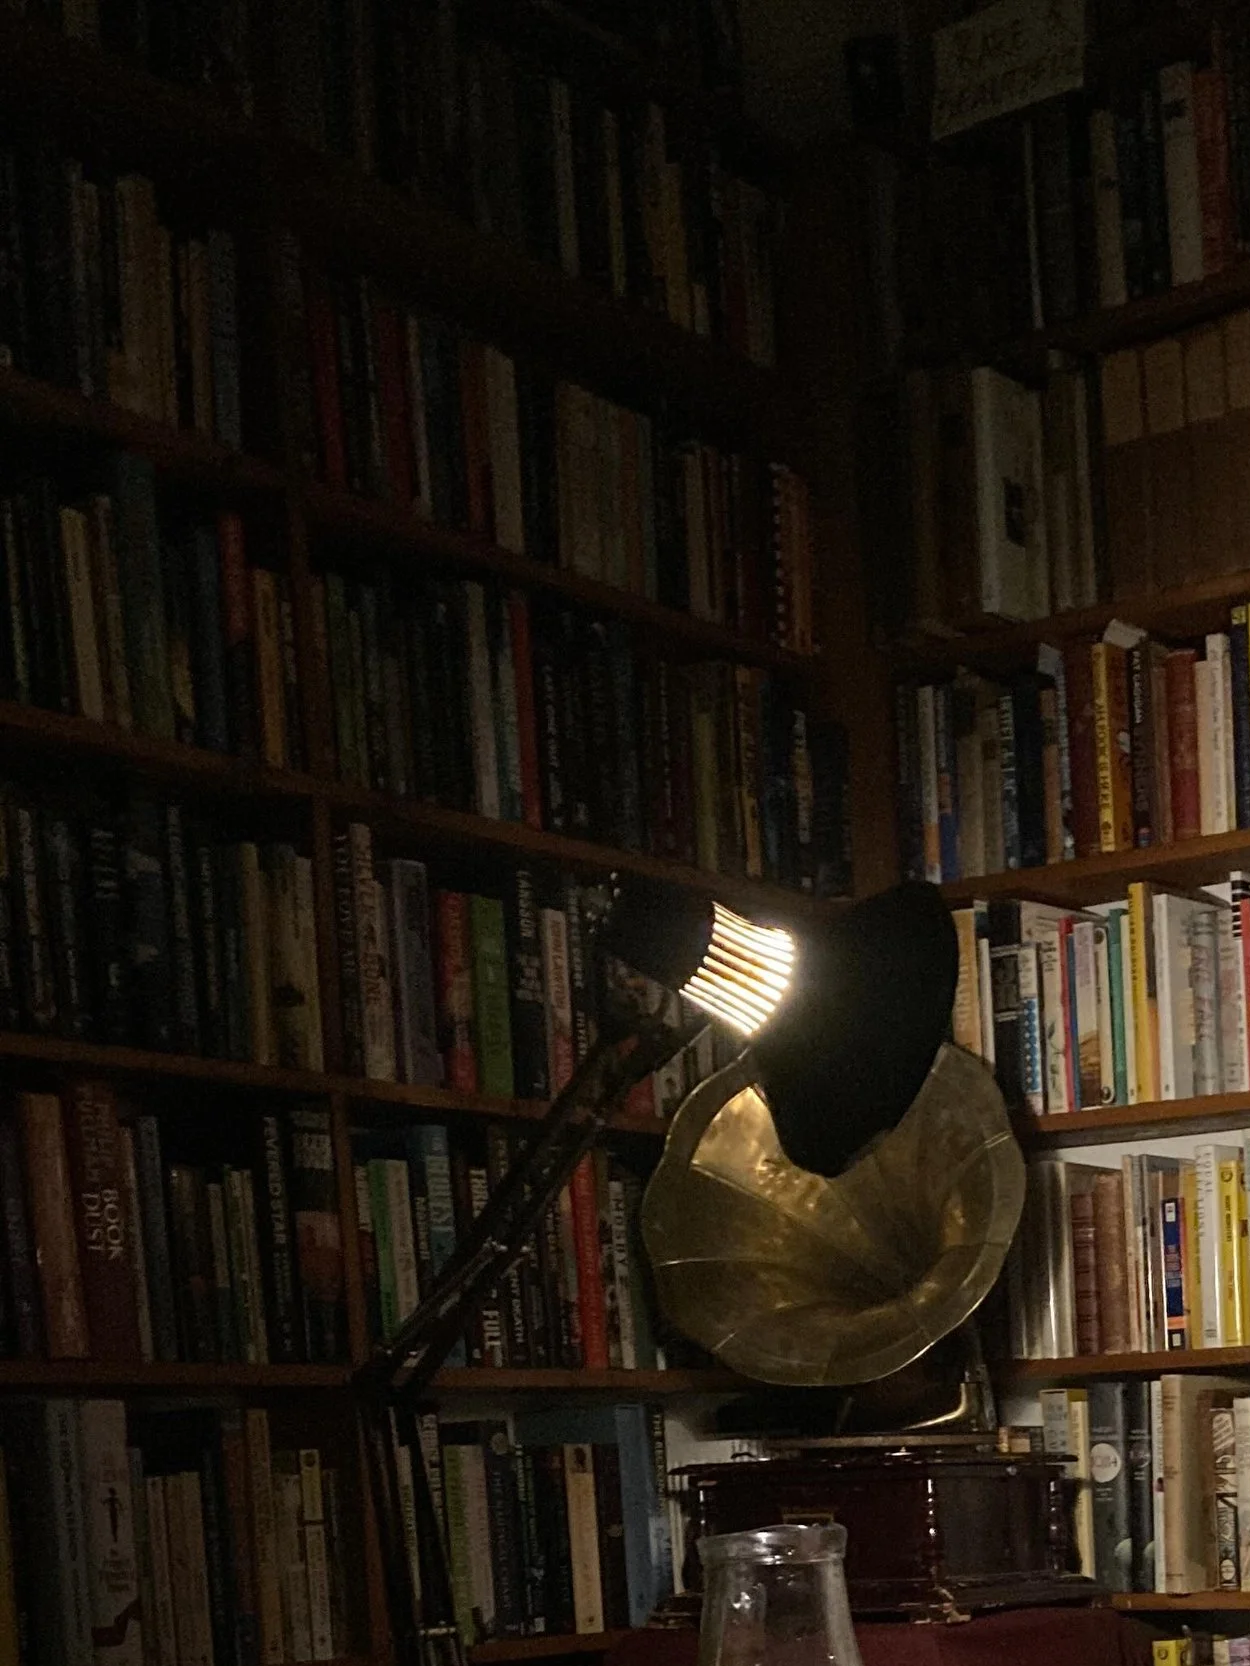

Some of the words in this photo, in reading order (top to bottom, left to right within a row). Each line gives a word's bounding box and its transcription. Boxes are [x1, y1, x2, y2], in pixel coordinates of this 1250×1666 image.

[262, 1116, 282, 1197] FEVERED
[78, 1192, 104, 1252] DUST
[101, 1188, 124, 1261] BOOK
[270, 1200, 287, 1245] STAR
[482, 1310, 501, 1350] FULL
[511, 1298, 524, 1344] DEATH
